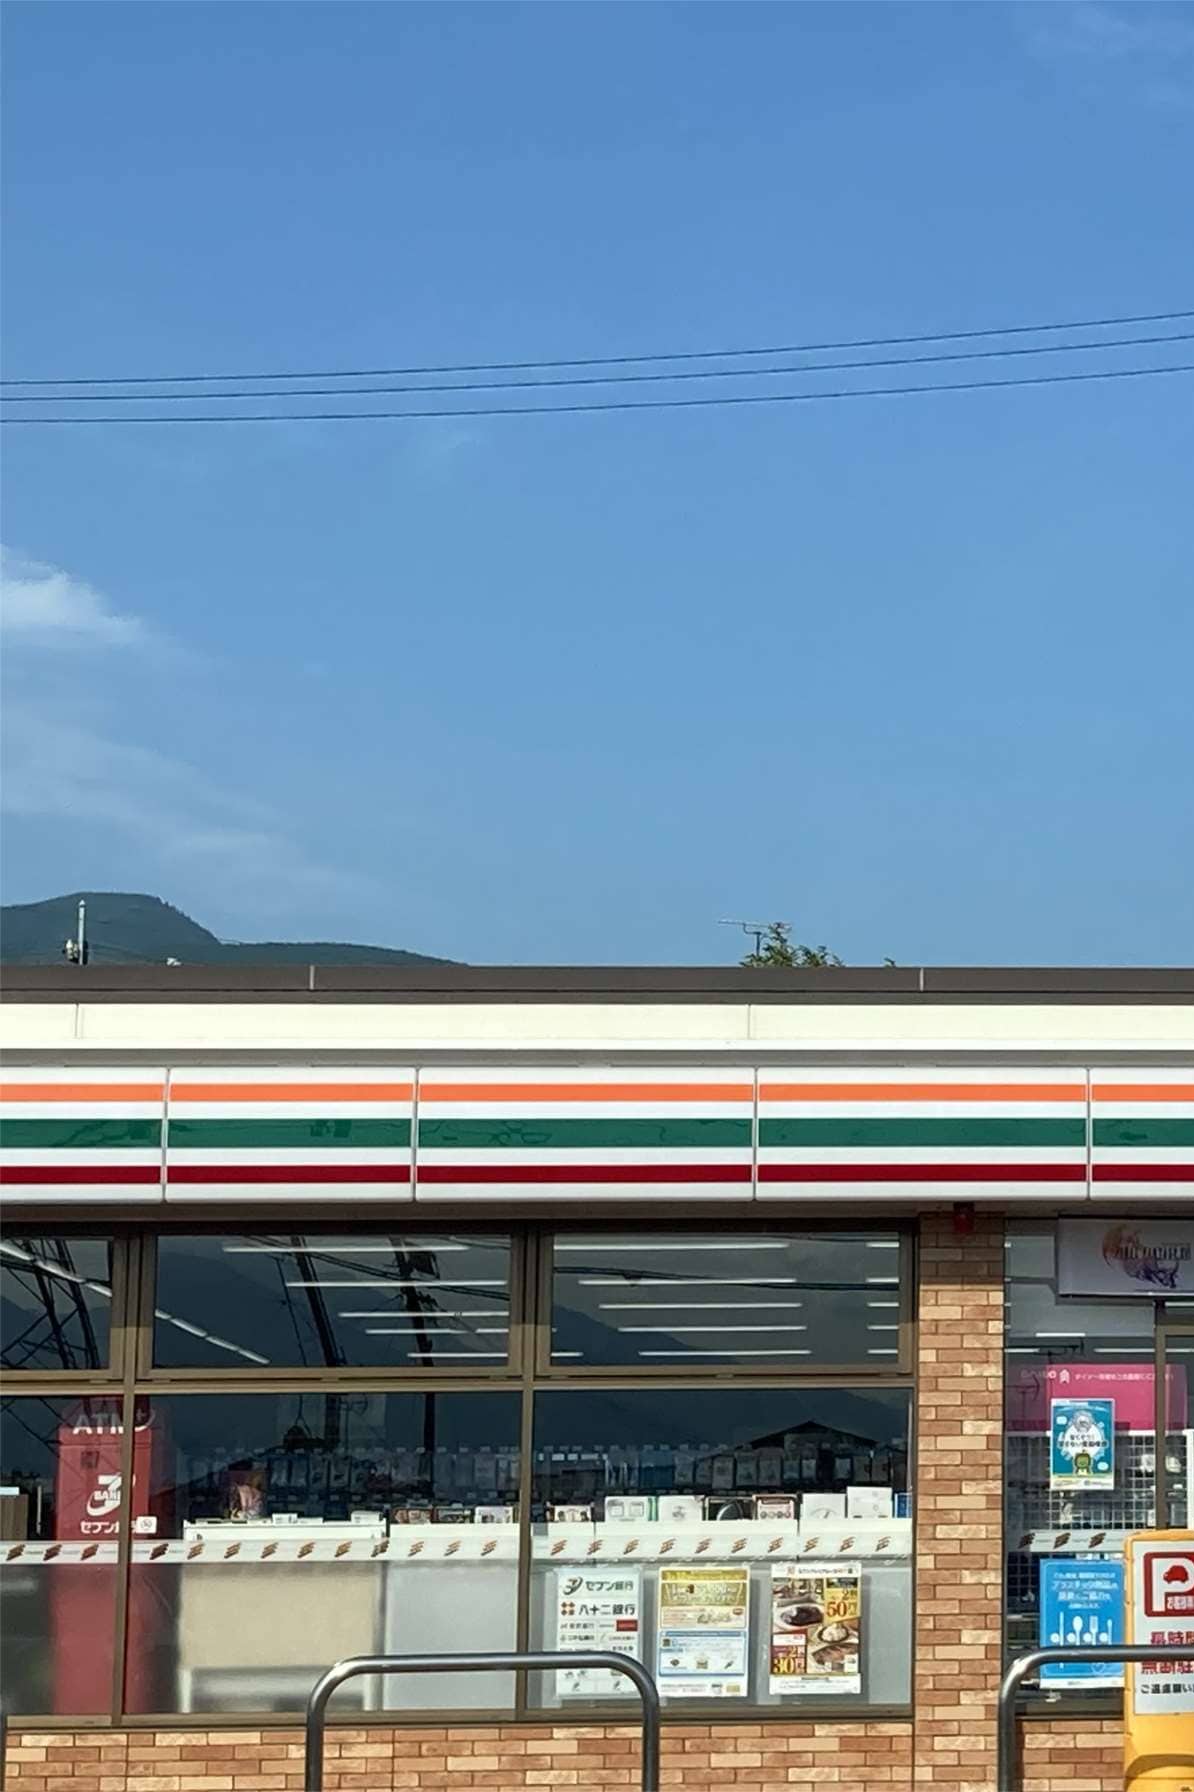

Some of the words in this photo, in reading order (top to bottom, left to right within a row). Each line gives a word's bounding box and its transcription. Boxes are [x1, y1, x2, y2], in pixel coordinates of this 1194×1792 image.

[585, 1581, 634, 1592] セブン銀行
[579, 1604, 635, 1615] 八十二銀行
